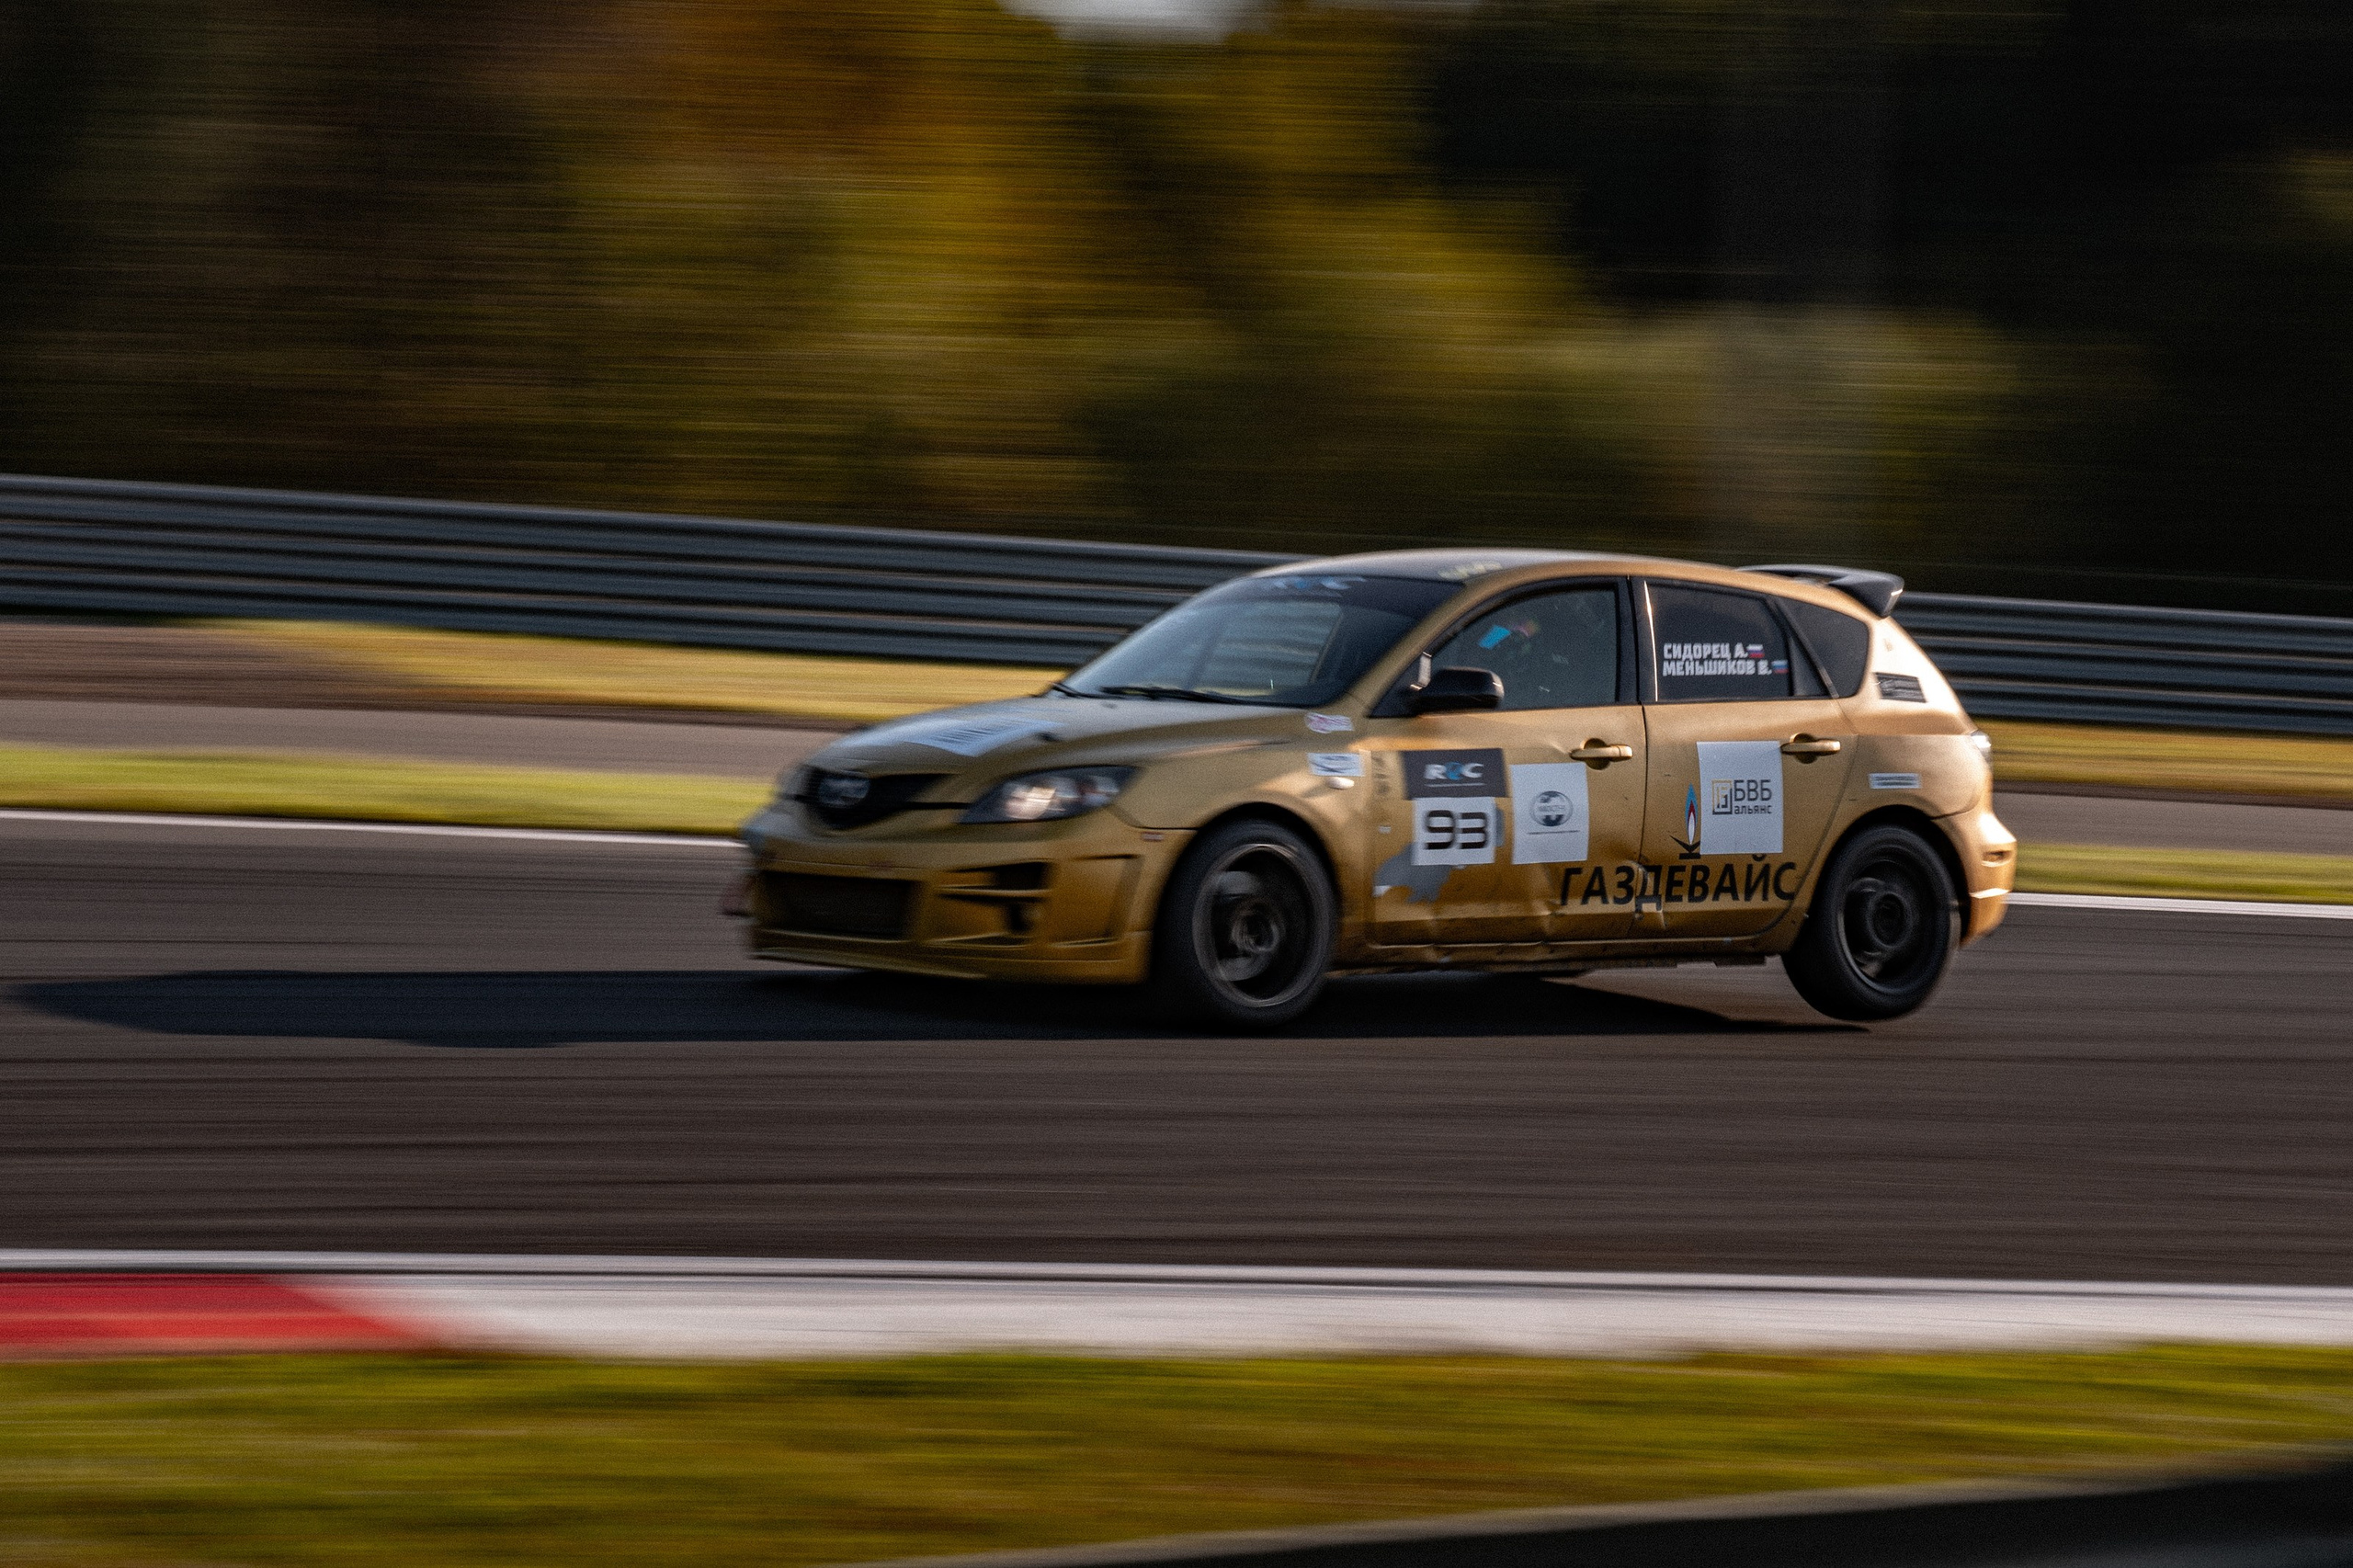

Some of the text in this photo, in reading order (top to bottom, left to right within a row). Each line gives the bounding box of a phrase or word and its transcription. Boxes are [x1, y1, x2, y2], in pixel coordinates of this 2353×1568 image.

[1663, 643, 1731, 661] СИДОРЕЦ
[1663, 660, 1756, 676] МЕНЬШИКОВ
[1733, 779, 1772, 801] БВБ
[1733, 804, 1772, 814] альянс
[1426, 810, 1487, 849] 93
[1560, 853, 1797, 913] ГАЗДЕВАЙС
